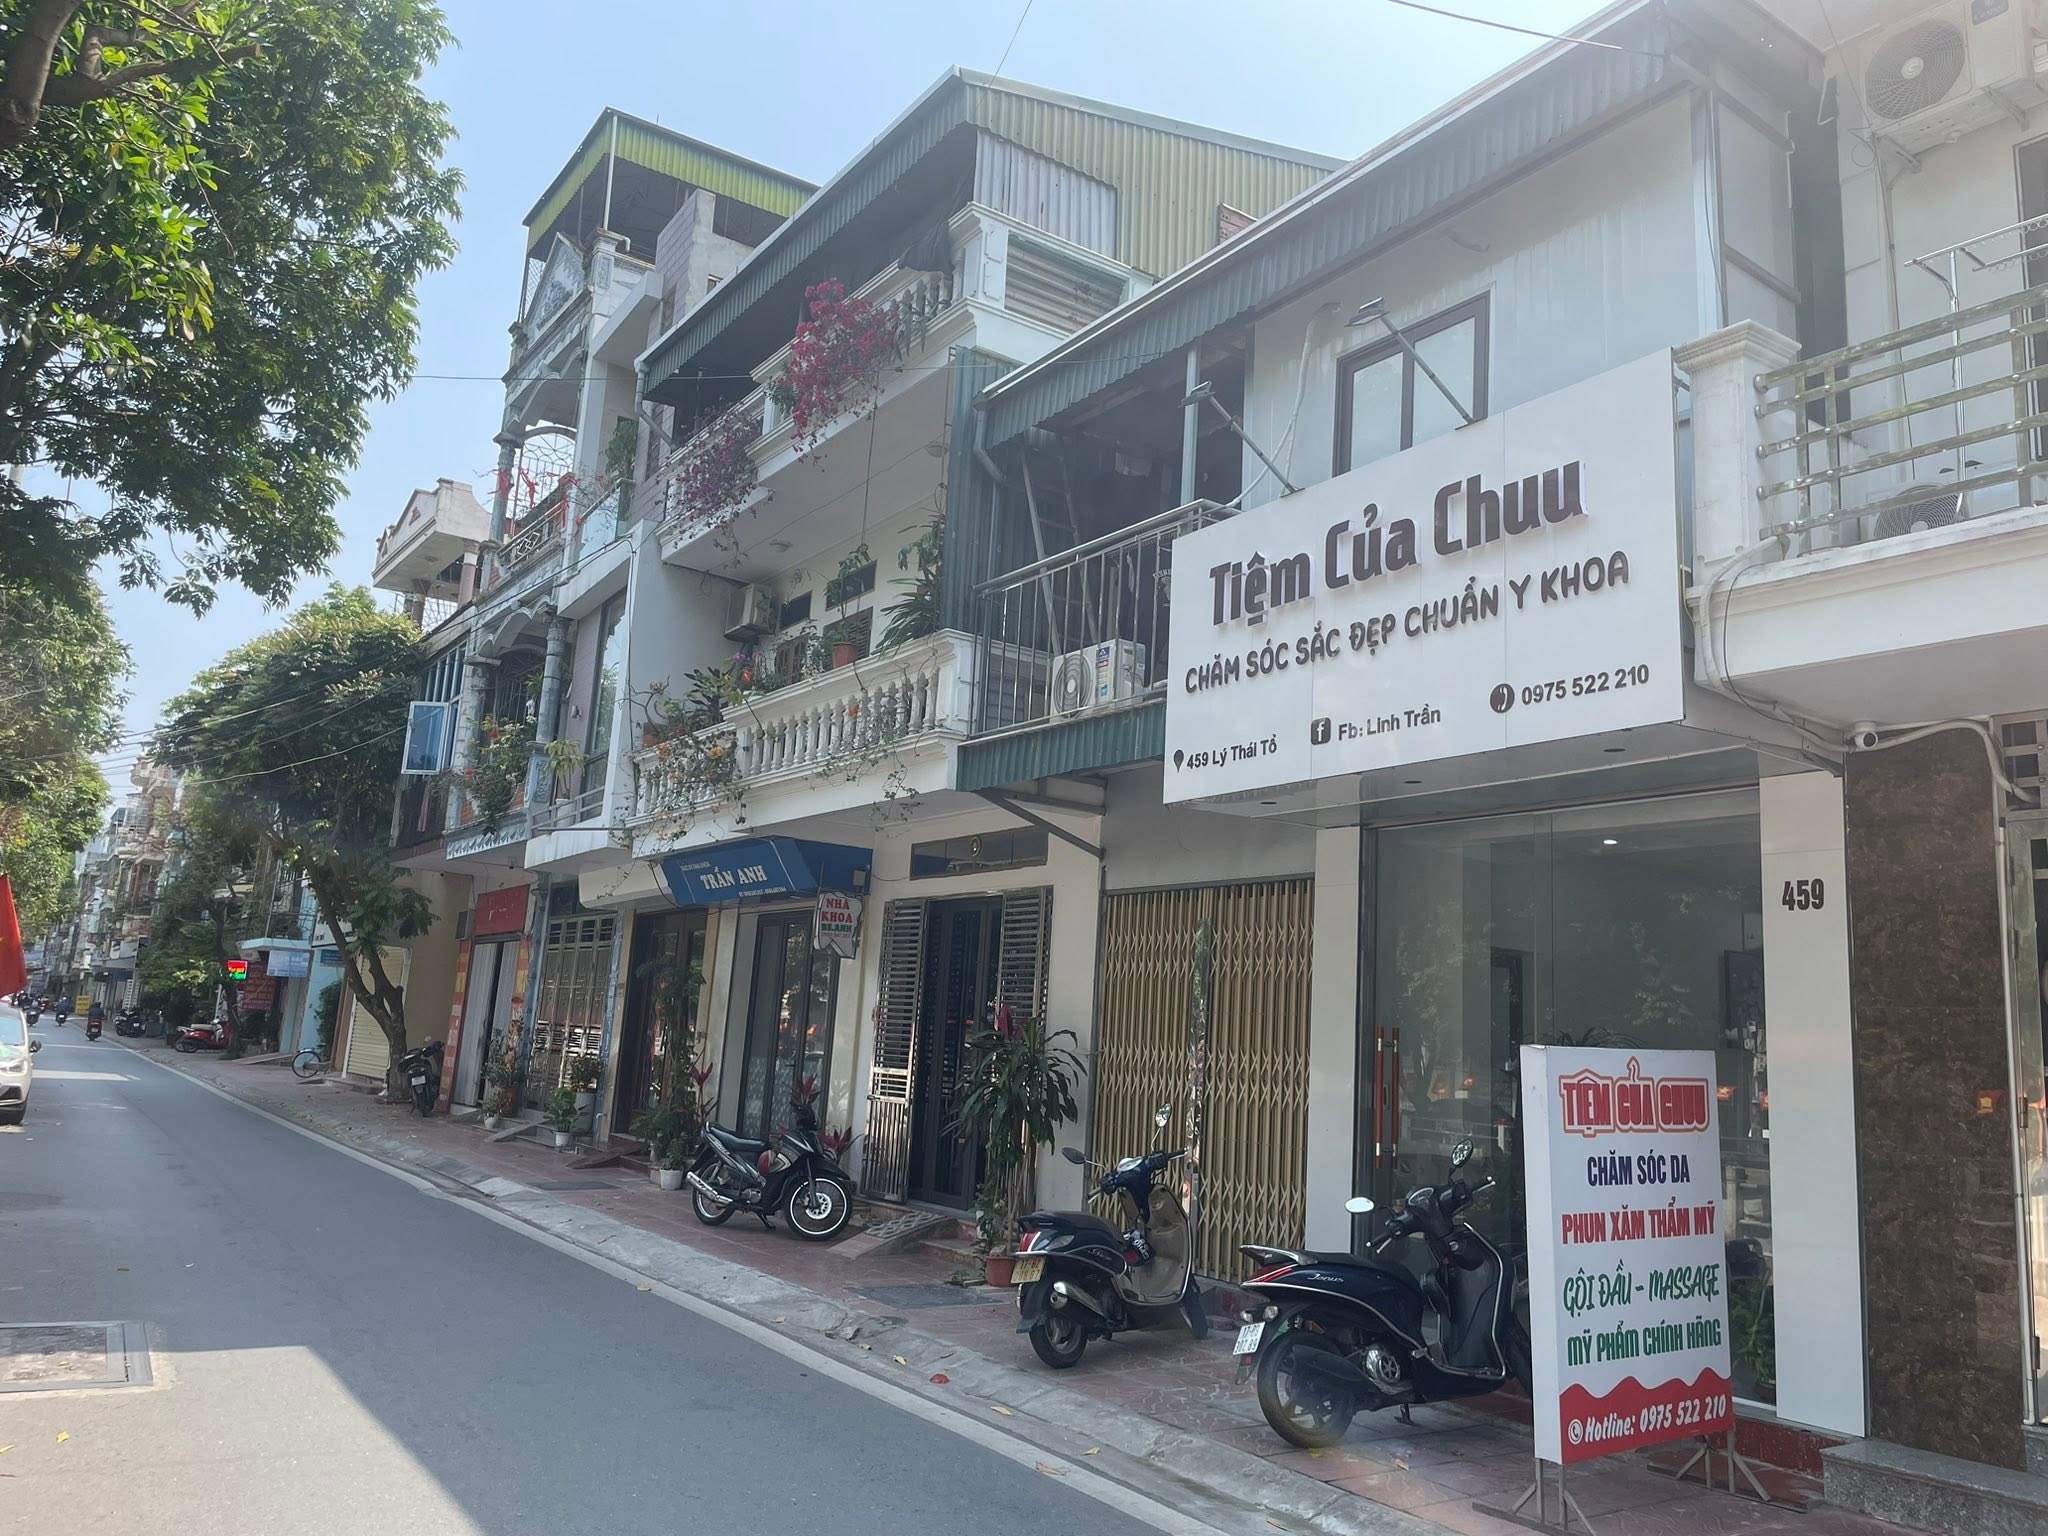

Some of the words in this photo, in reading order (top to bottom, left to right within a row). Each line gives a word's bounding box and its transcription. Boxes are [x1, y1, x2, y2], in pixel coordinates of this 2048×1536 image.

[1210, 552, 1312, 627] Tiệm
[1325, 503, 1418, 589] Của
[1434, 460, 1585, 556] Chuu
[1185, 653, 1240, 694] CHĂM
[1246, 638, 1289, 678] SÓC
[1295, 620, 1341, 665] SẮC
[1349, 613, 1397, 656] ĐẸP
[1404, 576, 1499, 637] CHUẨN
[1509, 574, 1531, 610] Y
[1541, 551, 1629, 603] KHOA
[1521, 680, 1567, 705] 0975
[1572, 671, 1609, 696] 522
[1614, 664, 1649, 689] 210
[1338, 724, 1364, 741] Fb:
[1366, 714, 1400, 735] Linh
[1404, 704, 1441, 728] Trần
[1186, 751, 1209, 769] 459
[1212, 748, 1228, 768] Lý
[1231, 741, 1257, 761] Thái
[1260, 734, 1278, 753] Tổ
[738, 865, 768, 885] ANH
[1781, 878, 1825, 911] 459
[821, 911, 853, 923] KHOA
[825, 898, 850, 910] NHA
[1561, 1073, 1613, 1132] TIỆM
[1587, 1150, 1632, 1187] CHĂM
[1637, 1149, 1666, 1184] SÓC
[1670, 1155, 1690, 1183] DA
[1562, 1212, 1606, 1244] PHUN
[1610, 1204, 1645, 1241] XĂM
[1648, 1196, 1690, 1238] THẨM
[1694, 1200, 1715, 1235] MỸ
[1563, 1267, 1595, 1318] GỘI
[1598, 1259, 1632, 1308] ĐẦU
[1649, 1263, 1720, 1302] MASSAGE
[1567, 1329, 1592, 1366] MỸ
[1596, 1320, 1639, 1362] PHẨM
[1643, 1319, 1683, 1356] CHÍNH
[1686, 1315, 1722, 1349] HÃNG
[1585, 1413, 1636, 1443] Hotline:
[1640, 1403, 1673, 1433] 0975
[1675, 1399, 1700, 1426] 522
[1704, 1394, 1727, 1420] 210
